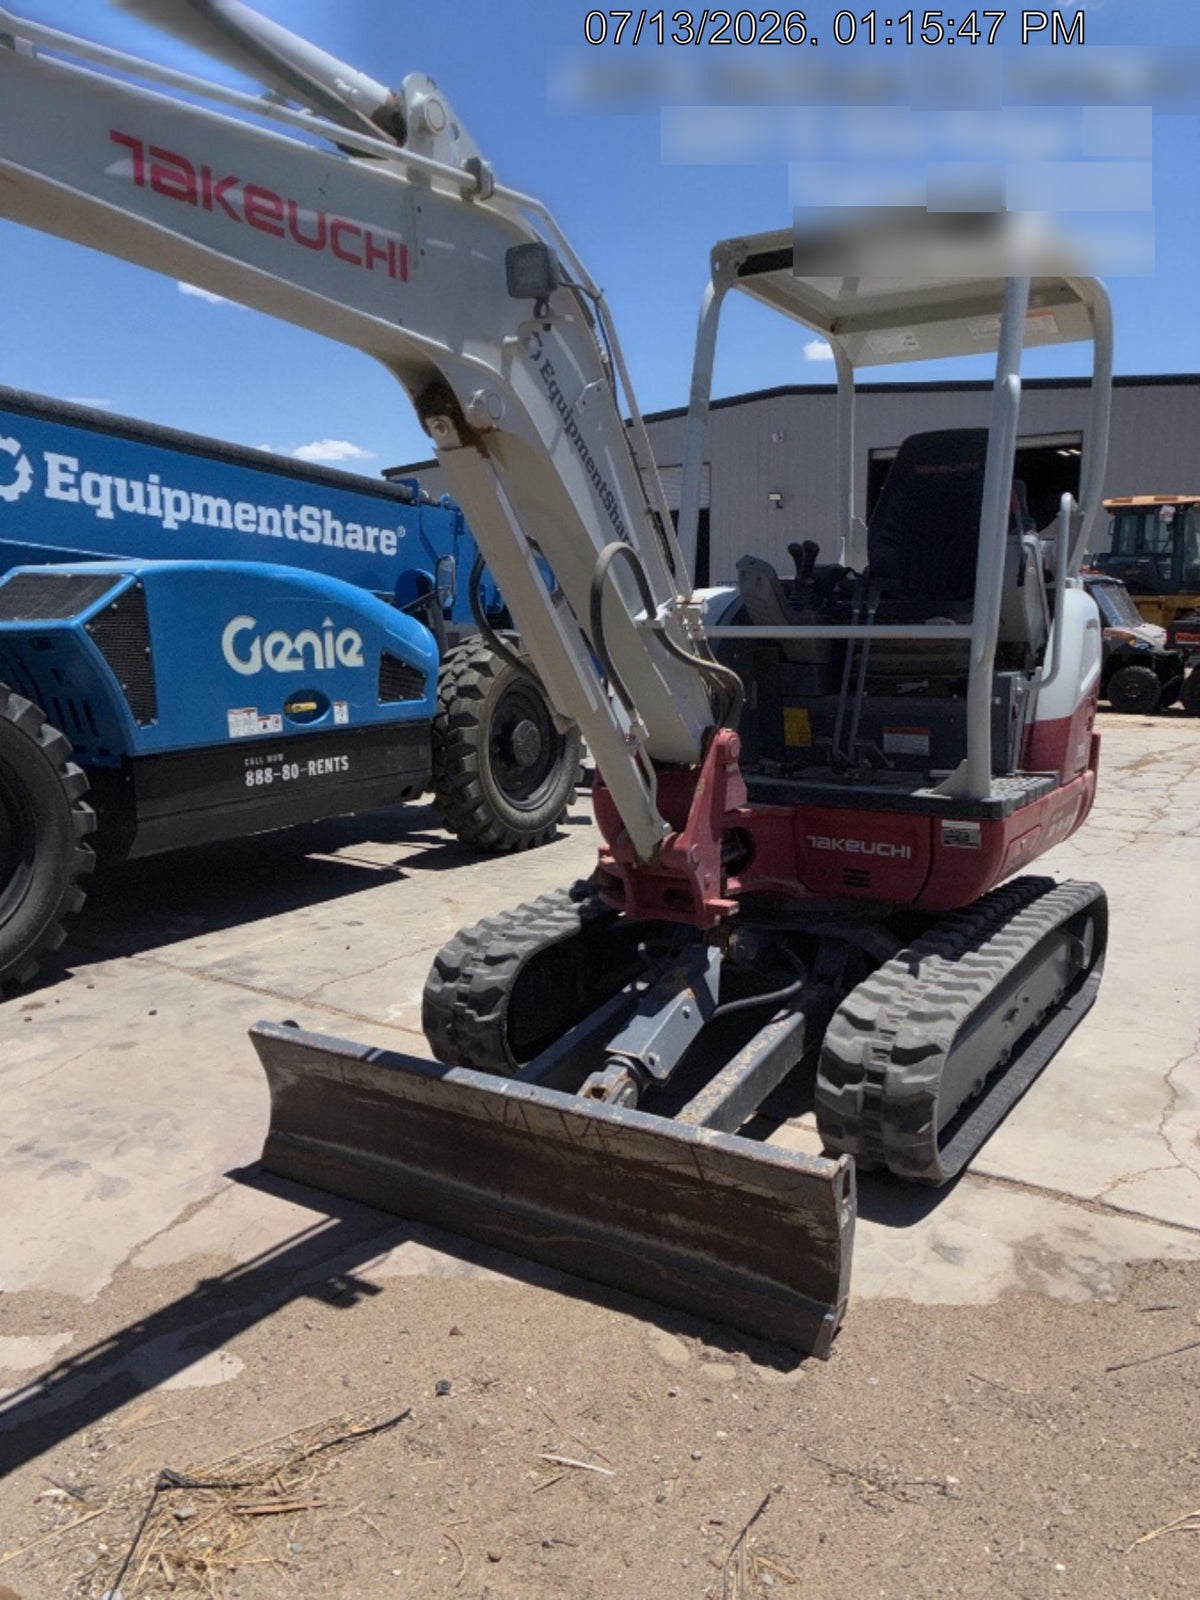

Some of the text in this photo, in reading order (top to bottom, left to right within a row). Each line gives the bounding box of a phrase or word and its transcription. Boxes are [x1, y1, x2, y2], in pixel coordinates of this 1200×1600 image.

[110, 129, 409, 283] TAKEUCHI
[539, 361, 635, 549] EquipmentShar
[221, 614, 365, 676] Genie
[245, 755, 350, 787] 888-80-RENTS
[806, 835, 912, 859] TAKEUCHI
